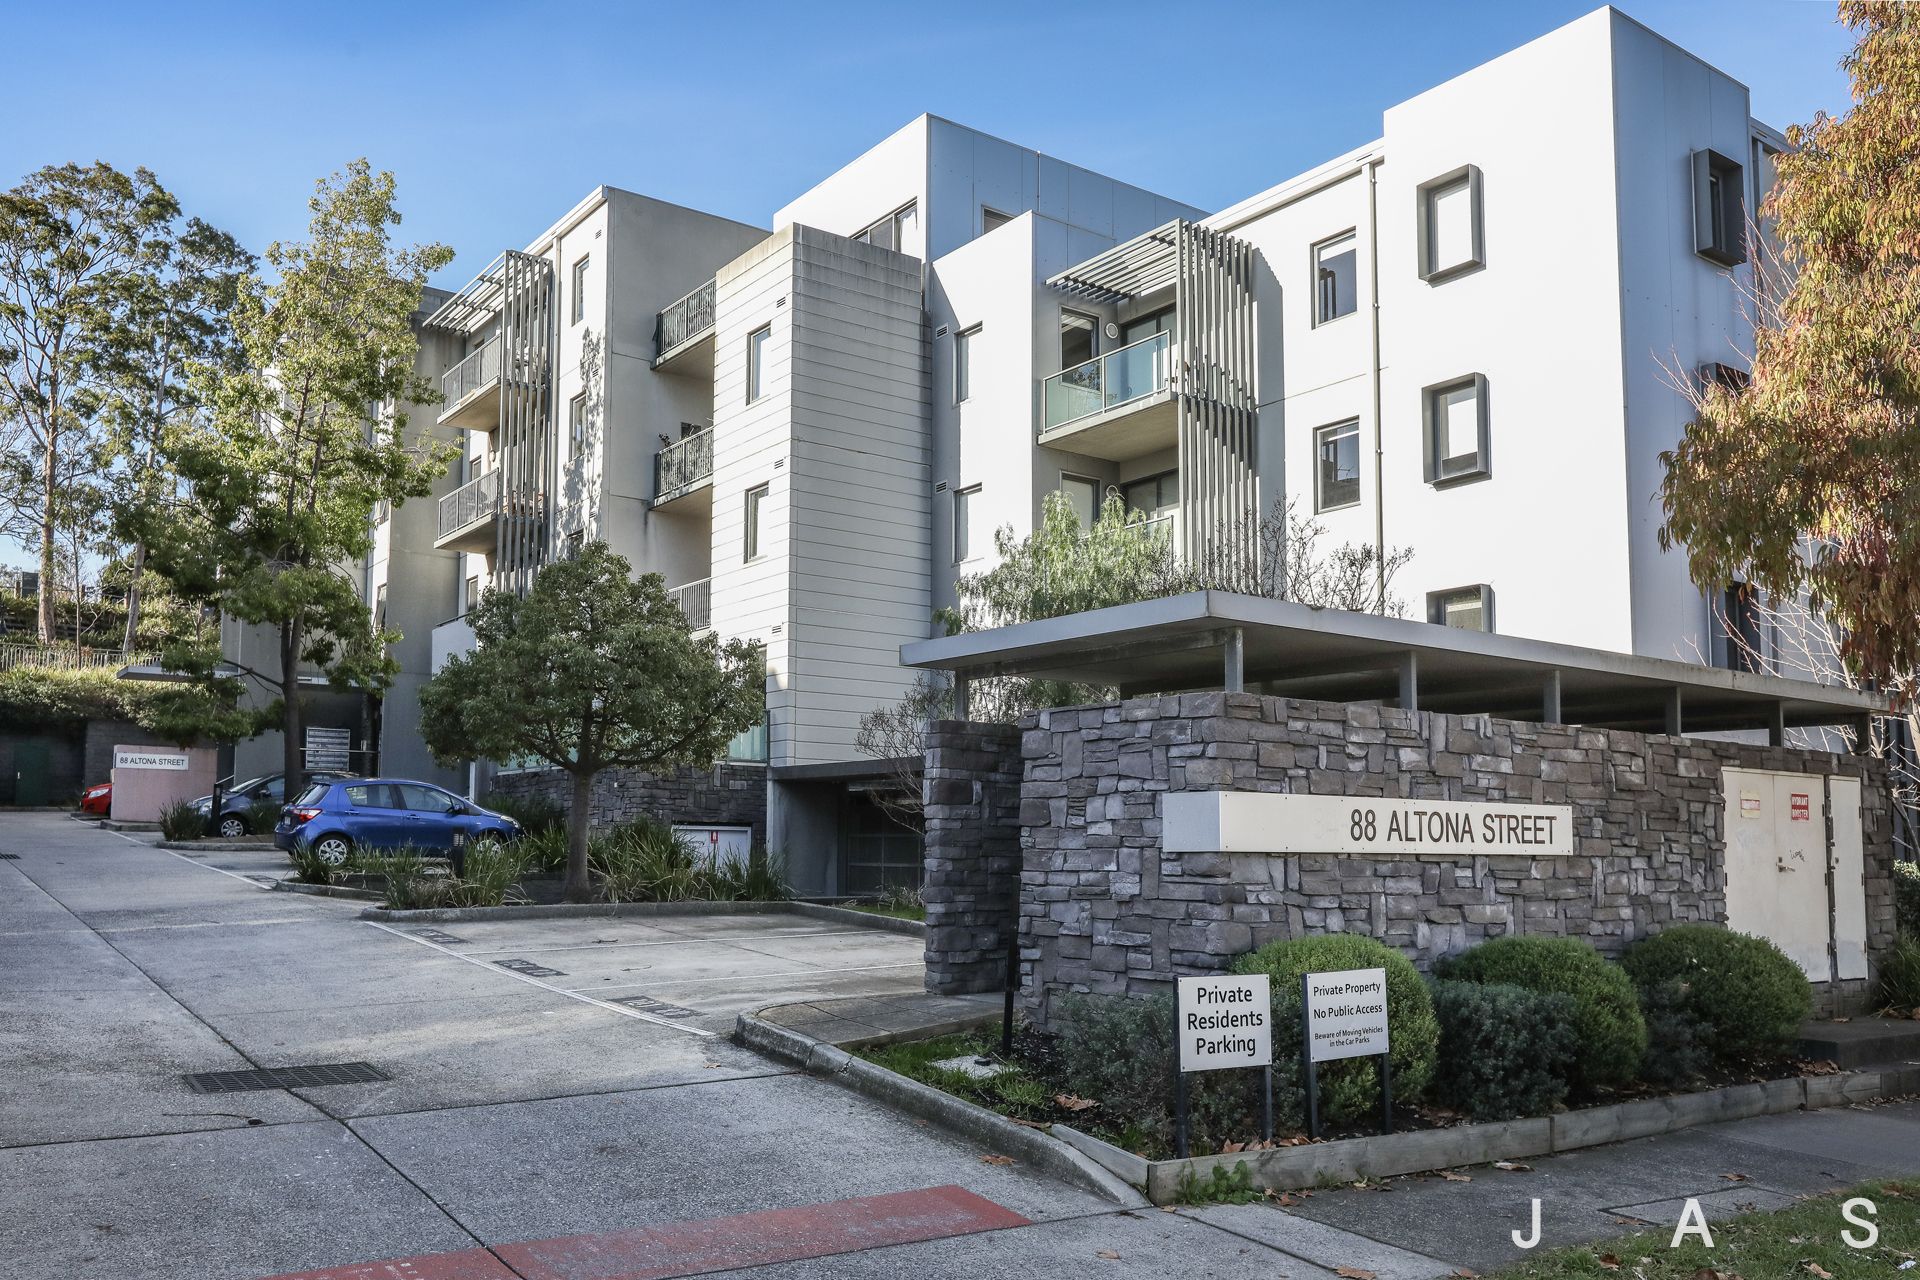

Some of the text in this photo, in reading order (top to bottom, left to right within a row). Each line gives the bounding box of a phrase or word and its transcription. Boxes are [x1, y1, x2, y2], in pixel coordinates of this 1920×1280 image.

[120, 756, 185, 766] 88 ALTONA STREET
[1350, 808, 1557, 845] 88 ALTONA STREET
[1197, 986, 1253, 1005] Private
[1313, 981, 1381, 997] Private Property
[1187, 1010, 1263, 1030] Residents
[1313, 1004, 1383, 1020] No Public Access
[1314, 1026, 1384, 1041] Beware of Moving Vehicles
[1329, 1036, 1370, 1047] in the Car Parks
[1196, 1034, 1256, 1056] Parking
